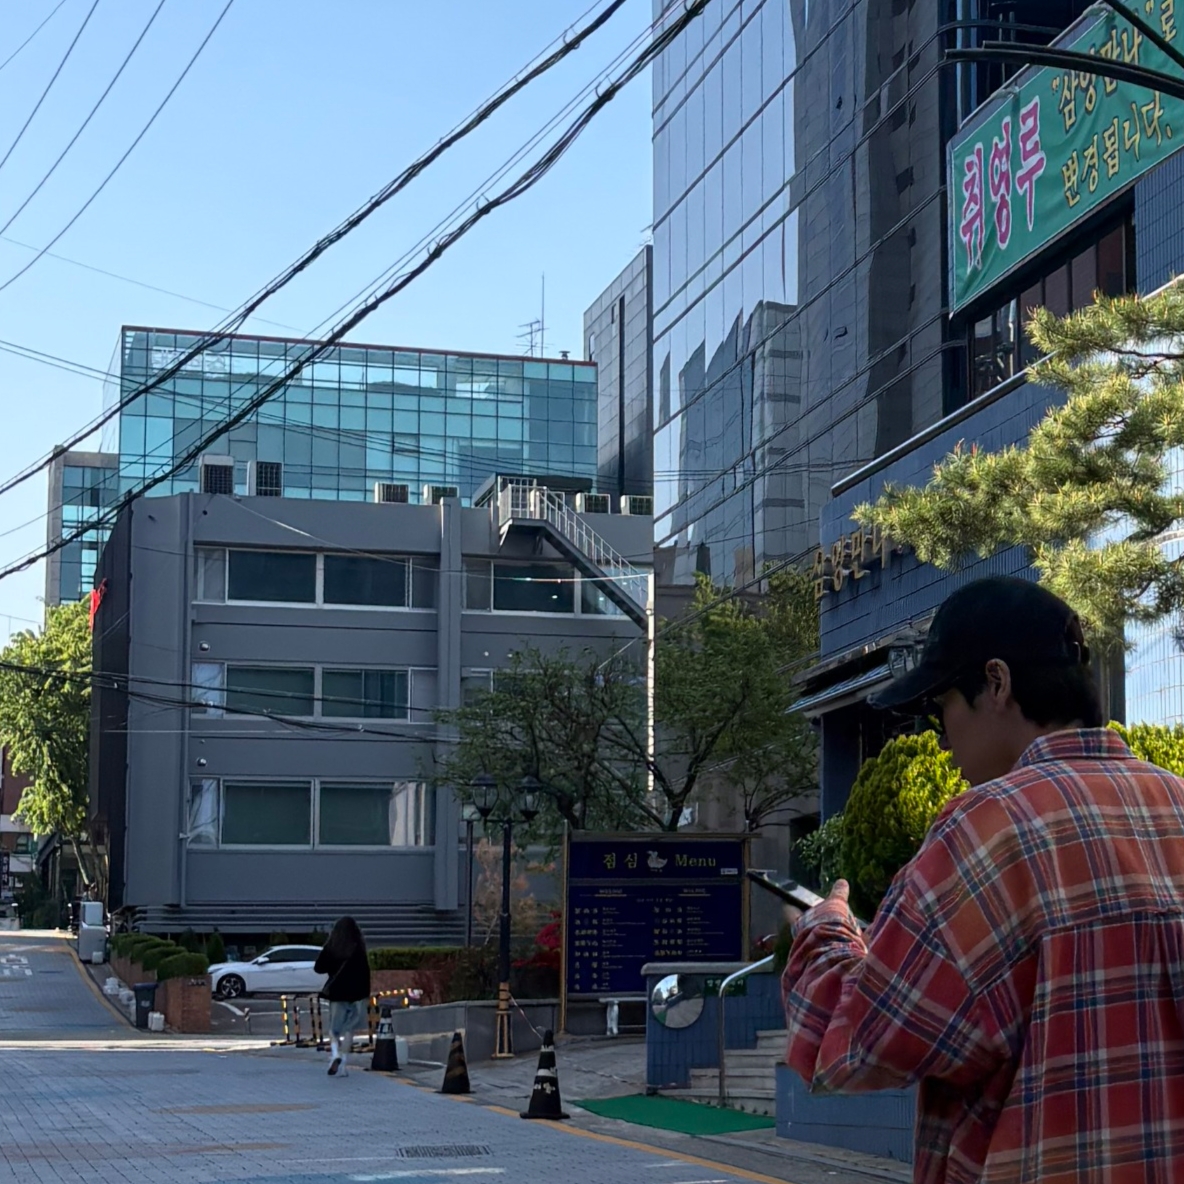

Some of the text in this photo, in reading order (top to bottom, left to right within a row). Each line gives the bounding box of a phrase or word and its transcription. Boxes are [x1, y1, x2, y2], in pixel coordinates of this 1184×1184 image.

[960, 96, 1047, 274] 취영루
[1061, 90, 1172, 208] 변경됩니다.
[675, 853, 717, 867] Menu
